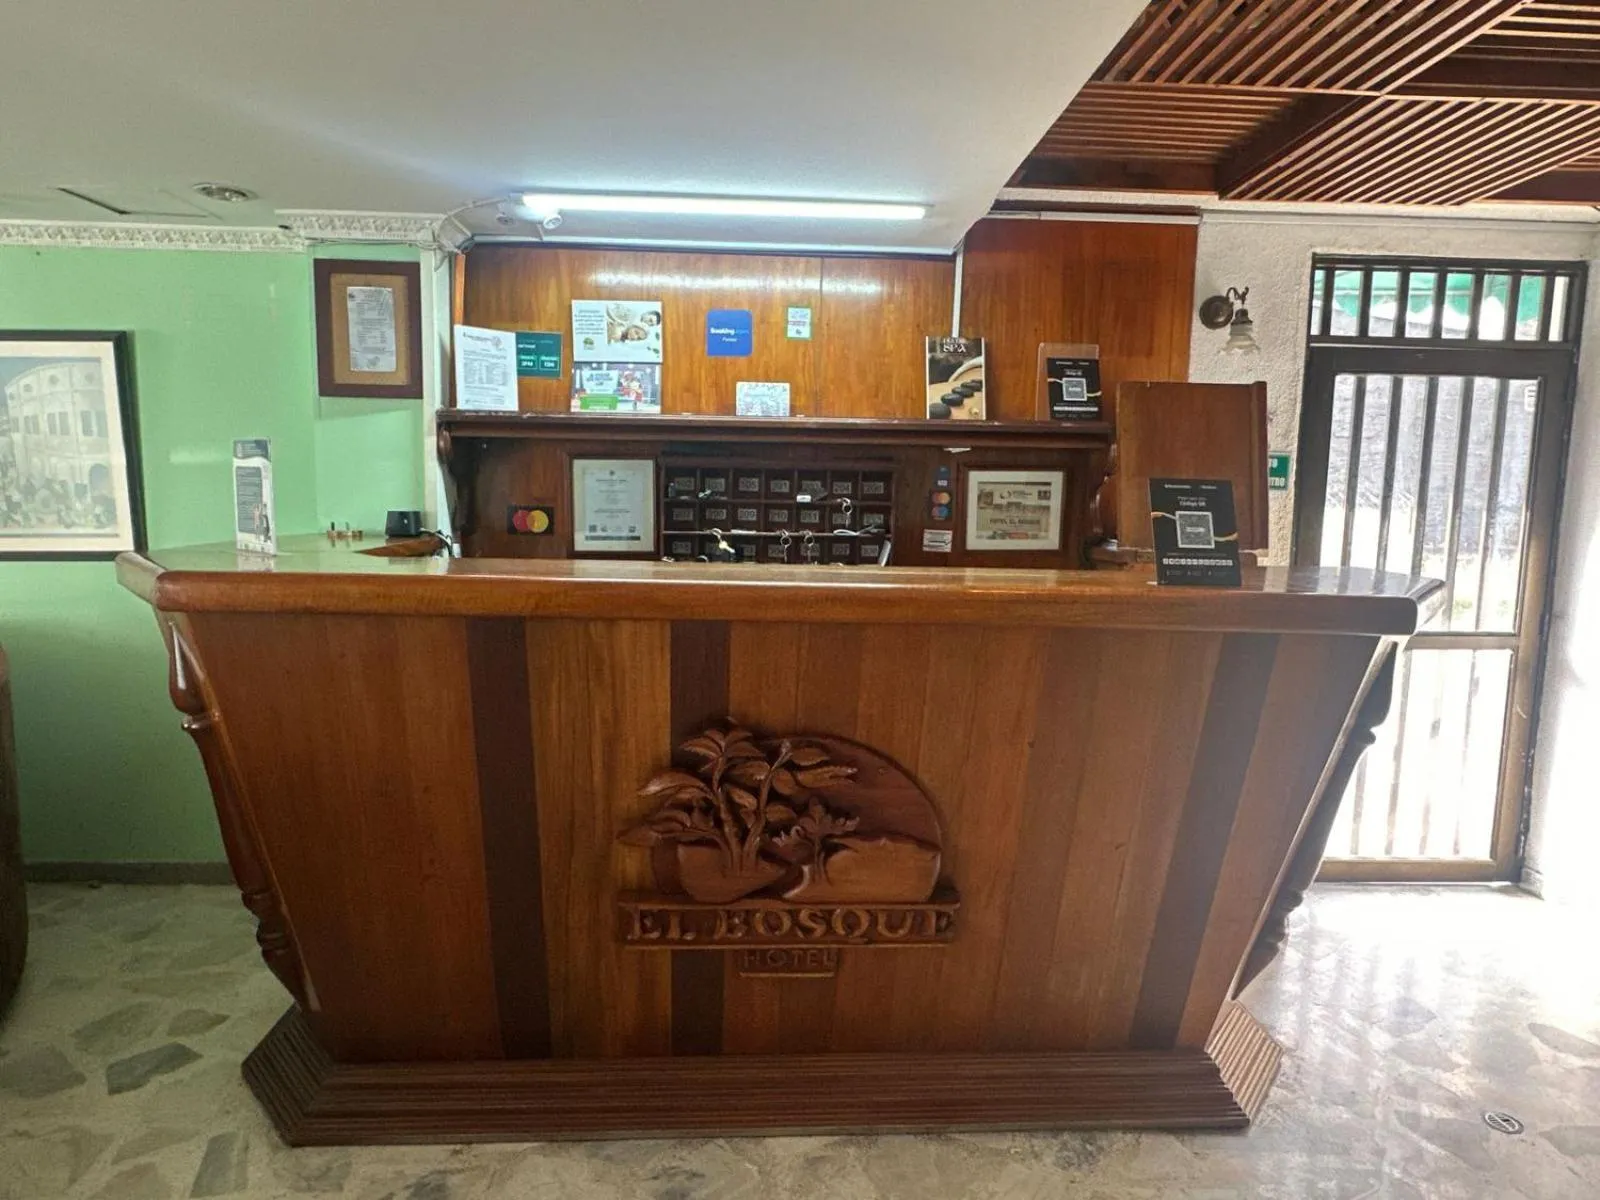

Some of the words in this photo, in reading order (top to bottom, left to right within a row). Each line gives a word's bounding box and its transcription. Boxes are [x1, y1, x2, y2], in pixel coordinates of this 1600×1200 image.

[626, 907, 696, 940] EL
[713, 906, 957, 942] BOSQUE
[742, 949, 838, 969] HOTEL
